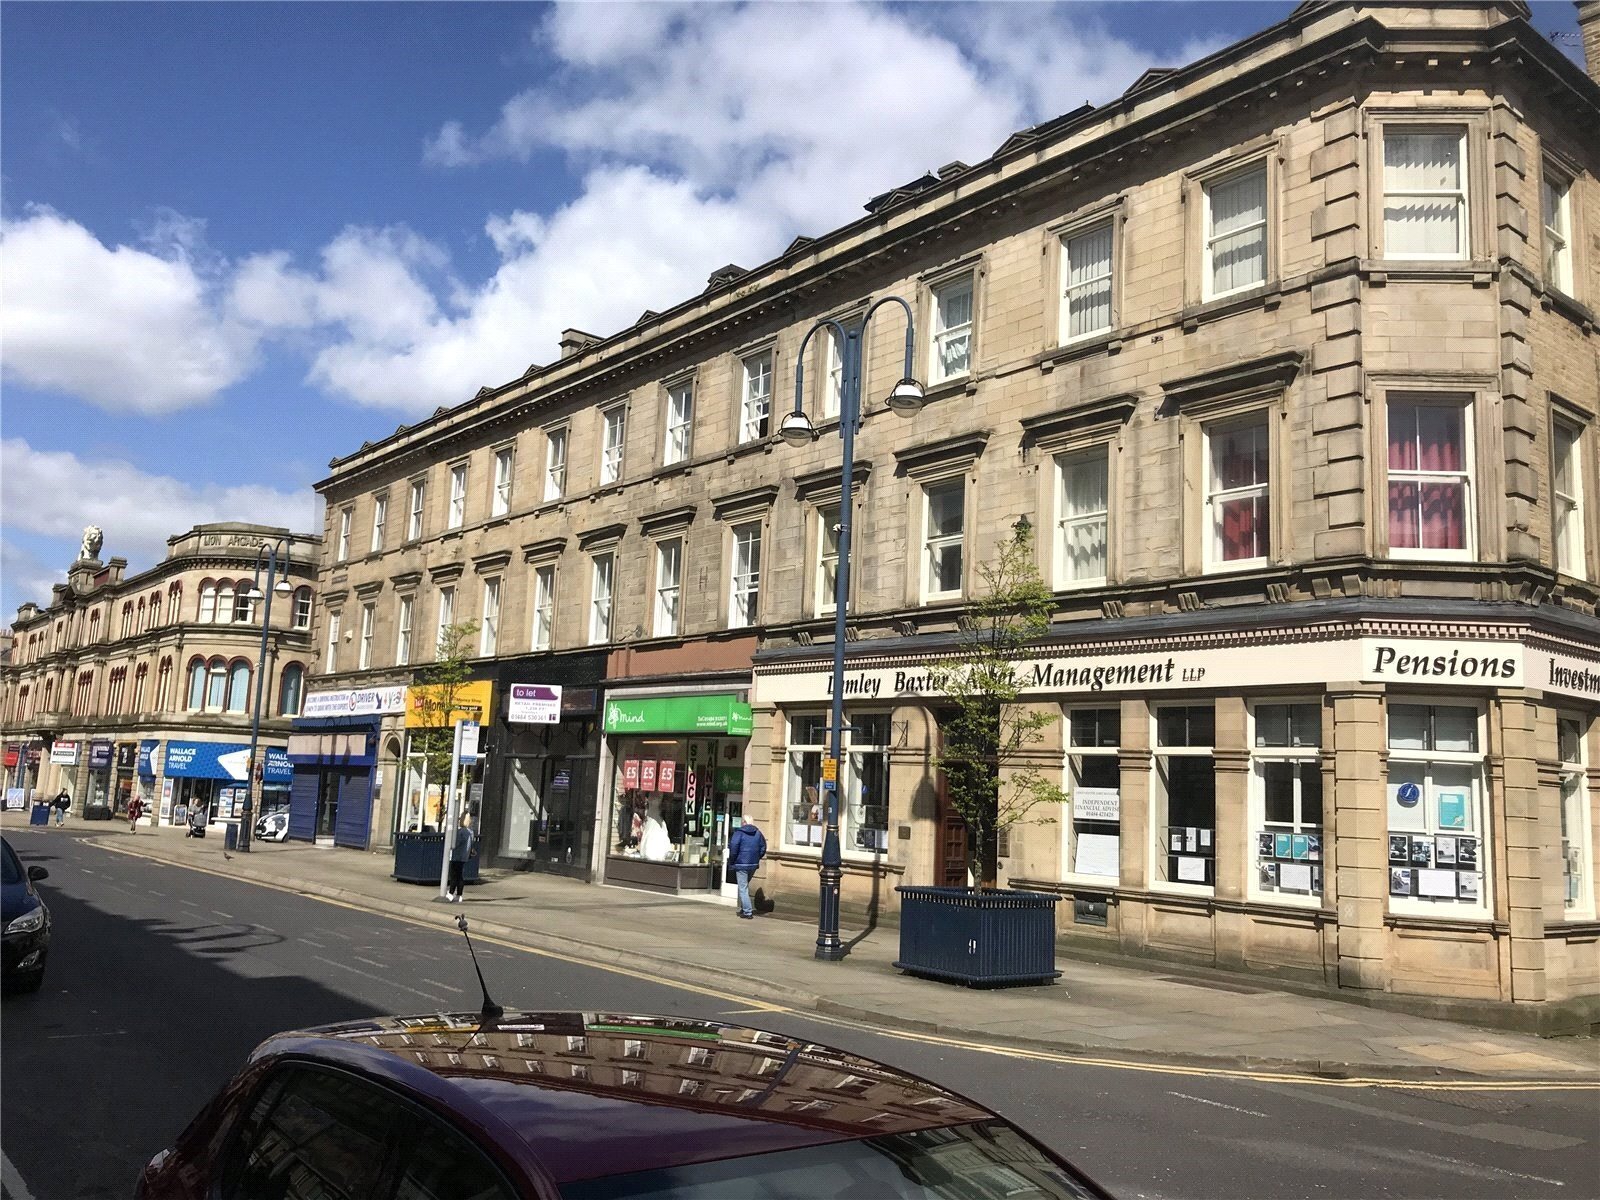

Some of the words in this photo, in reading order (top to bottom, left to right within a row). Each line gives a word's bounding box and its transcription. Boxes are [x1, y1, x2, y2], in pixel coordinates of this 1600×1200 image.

[204, 535, 222, 546] LION
[227, 536, 265, 548] ARCADE
[1372, 647, 1516, 678] Pensions
[827, 672, 881, 698] Lmley
[894, 671, 949, 692] Baxter
[1032, 658, 1175, 691] Management
[1182, 667, 1206, 682] LLP
[356, 692, 375, 703] DRIVER
[516, 689, 525, 697] to
[526, 689, 536, 697] let
[169, 747, 197, 756] WALLACE
[168, 755, 193, 763] ARNOLD
[168, 762, 187, 770] TRAVEL
[267, 767, 291, 775] TRAVEL
[626, 767, 637, 779] £5
[643, 767, 654, 780] £5
[661, 767, 673, 780] £5
[687, 744, 697, 814] STOCK
[703, 741, 715, 826] WANTED
